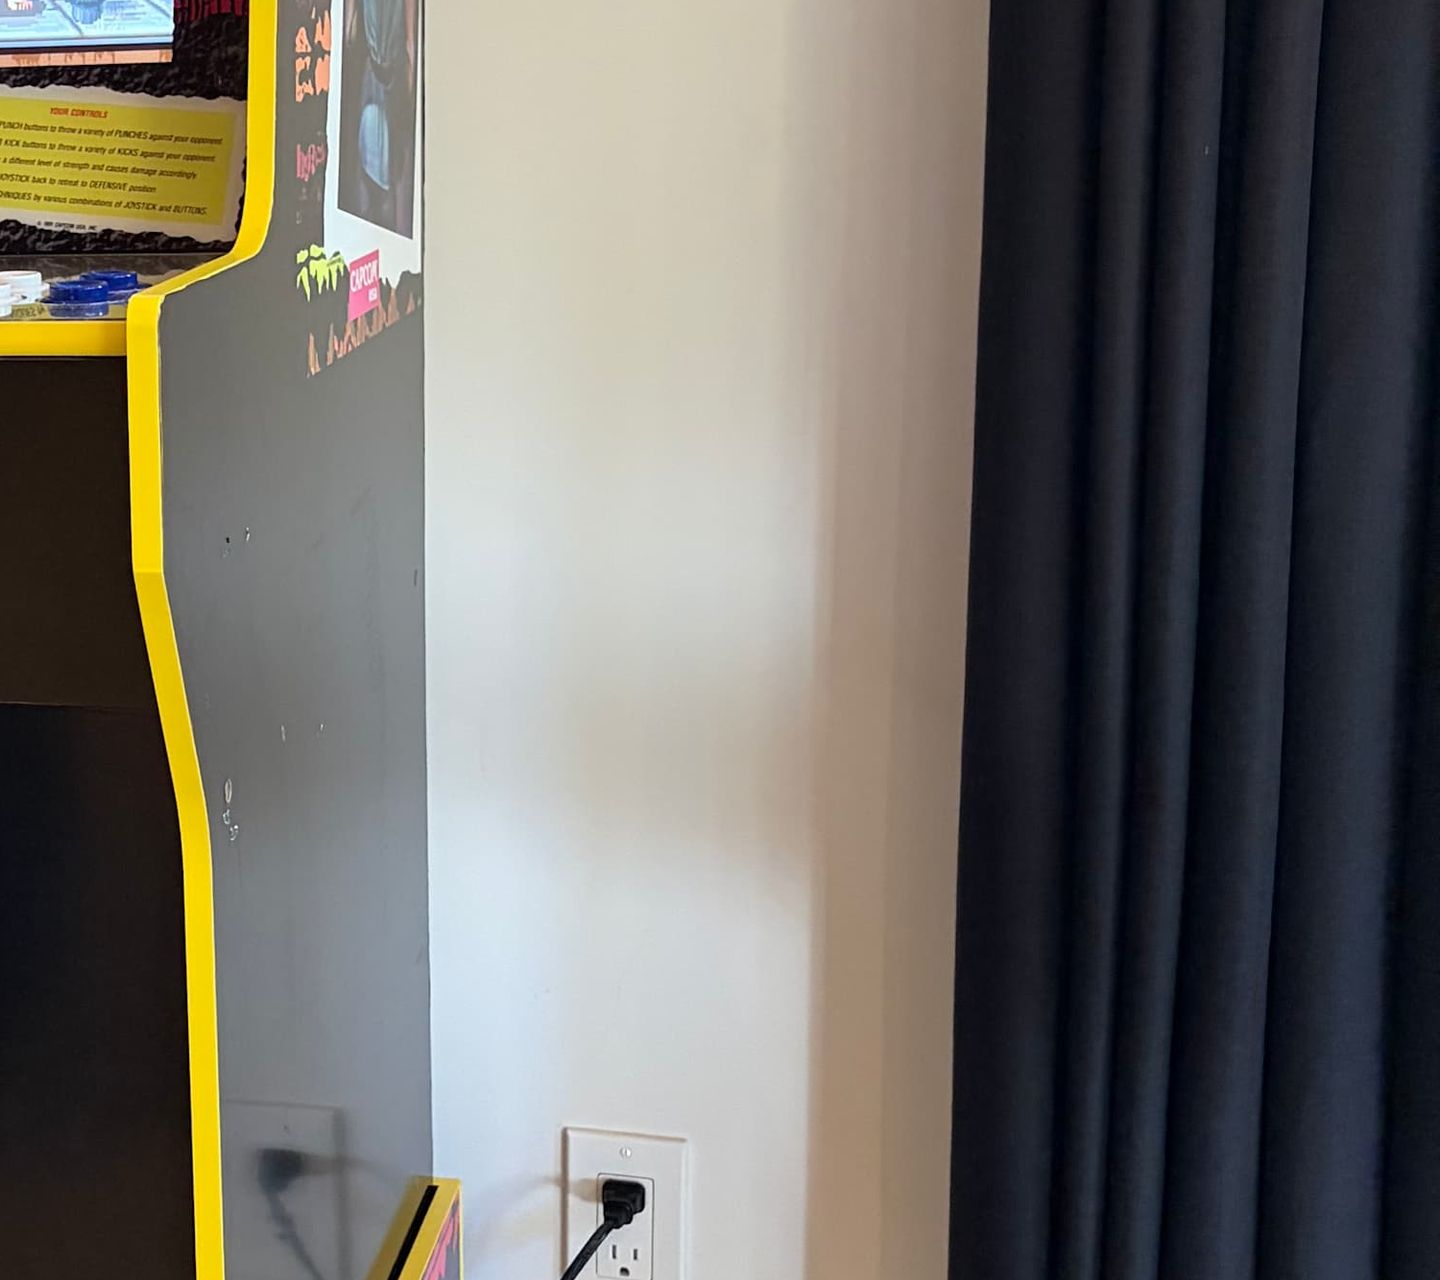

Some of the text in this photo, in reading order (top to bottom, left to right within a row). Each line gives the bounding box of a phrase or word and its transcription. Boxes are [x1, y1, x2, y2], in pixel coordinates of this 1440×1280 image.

[71, 109, 108, 118] CONTROLS
[0, 121, 23, 129] PUNCH
[24, 123, 49, 132] buttons
[58, 126, 77, 134] throw
[83, 128, 104, 137] variety
[114, 131, 149, 139] PUNCHES
[4, 139, 20, 147] KICK
[22, 141, 47, 149] buttons
[57, 143, 76, 151] throw
[85, 145, 106, 155] variety
[117, 148, 138, 156] KICKS
[166, 152, 182, 160] your
[8, 157, 35, 166] different
[37, 158, 52, 166] level
[91, 163, 104, 171] and
[130, 166, 157, 176] damage
[32, 176, 47, 184] back
[89, 181, 127, 191] DEFENSIVE
[33, 194, 42, 202] by
[43, 195, 67, 203] various
[123, 201, 156, 211] JOYSTICK
[159, 204, 171, 212] and
